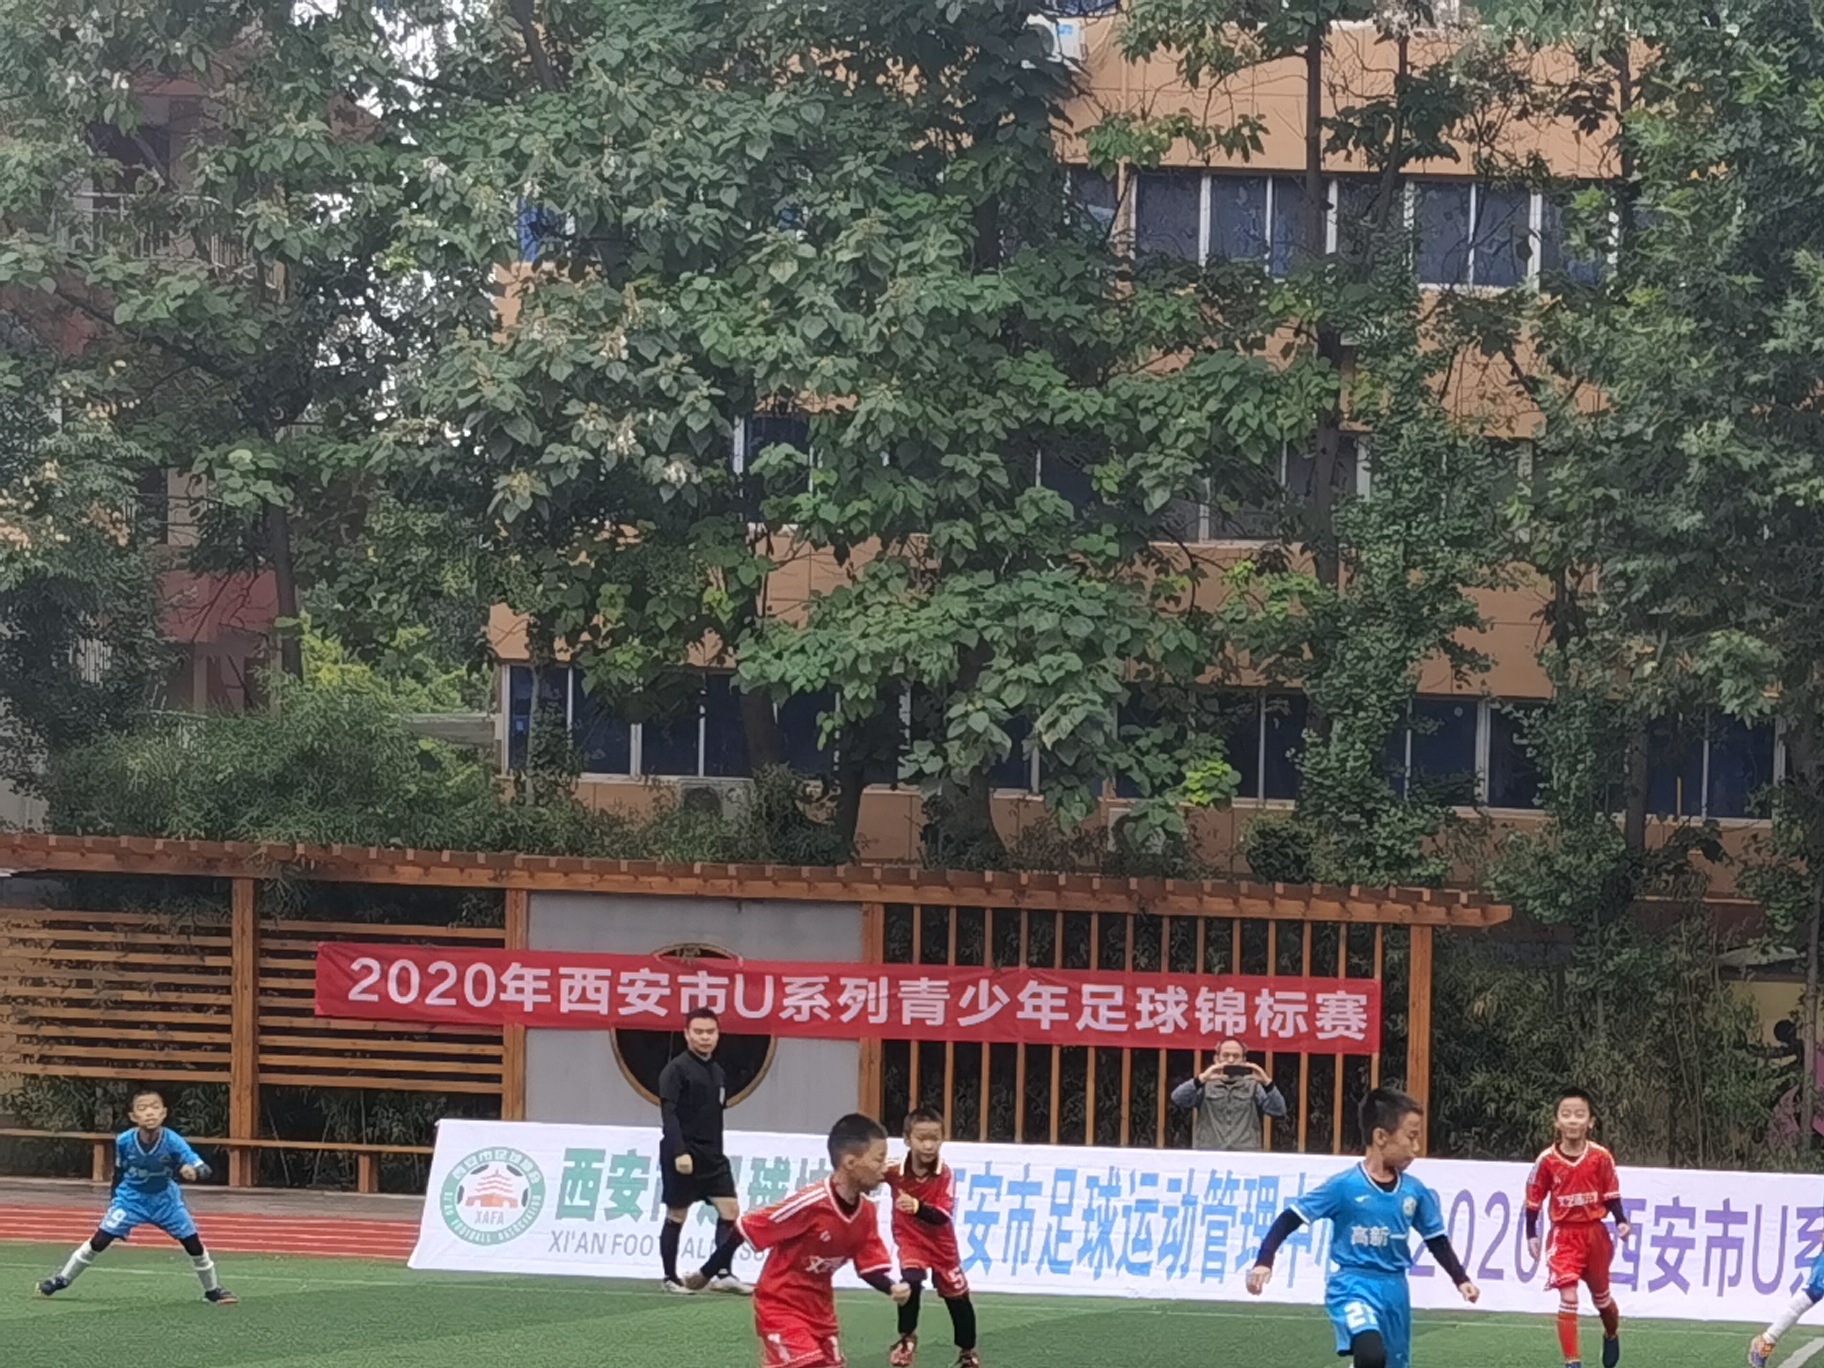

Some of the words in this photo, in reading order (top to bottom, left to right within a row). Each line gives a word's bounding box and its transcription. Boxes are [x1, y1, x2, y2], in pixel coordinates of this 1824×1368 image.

[347, 956, 1368, 1042] 2020年西安市U系列青少年足球锦标赛
[548, 1229, 607, 1256] XI'AN
